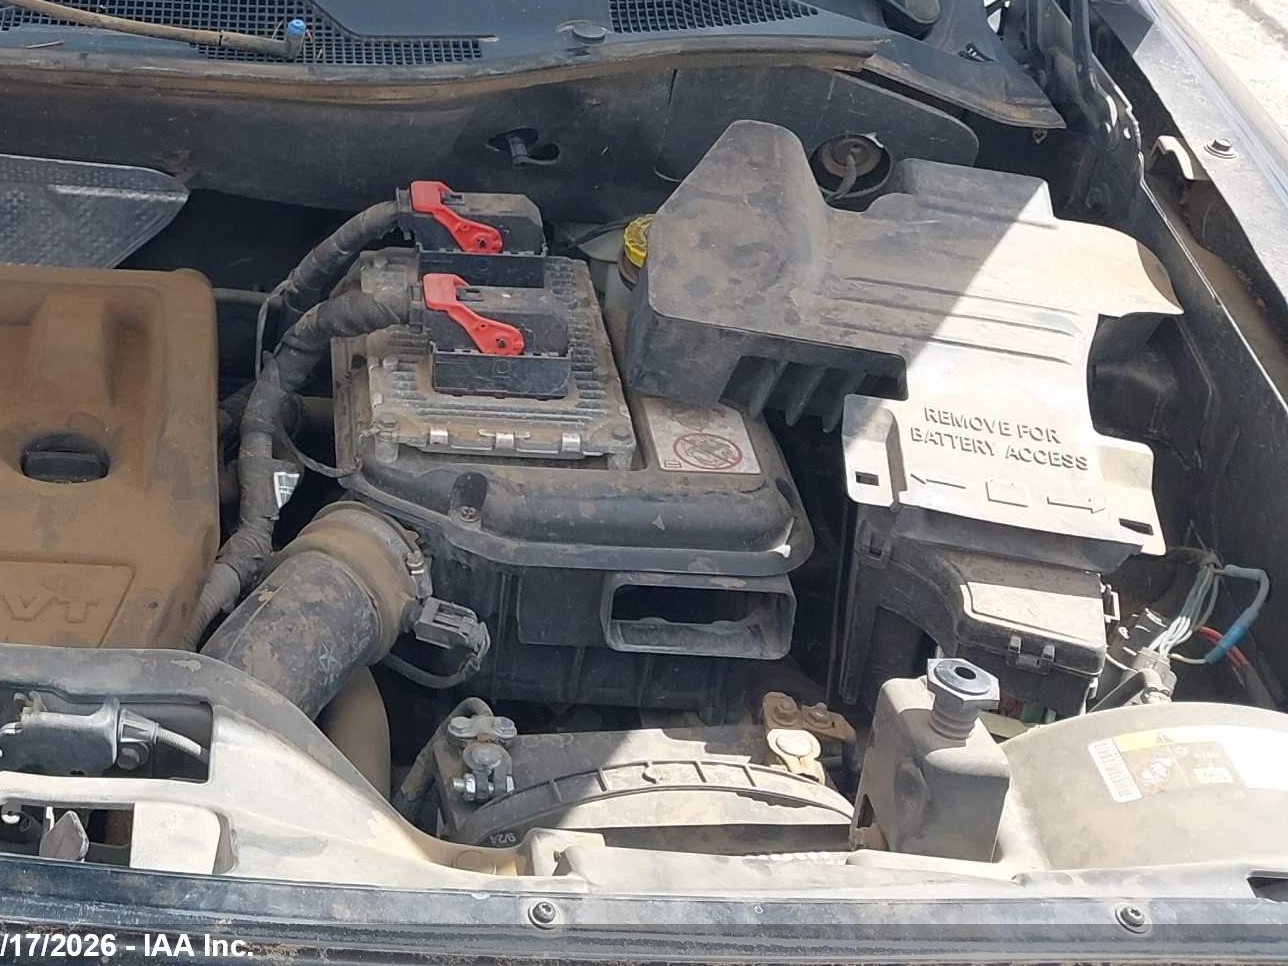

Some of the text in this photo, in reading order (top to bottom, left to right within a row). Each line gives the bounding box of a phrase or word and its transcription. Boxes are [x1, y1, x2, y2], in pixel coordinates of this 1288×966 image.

[924, 407, 1061, 445] REMOVE FOR
[910, 427, 1089, 471] BATTERY ACCESS
